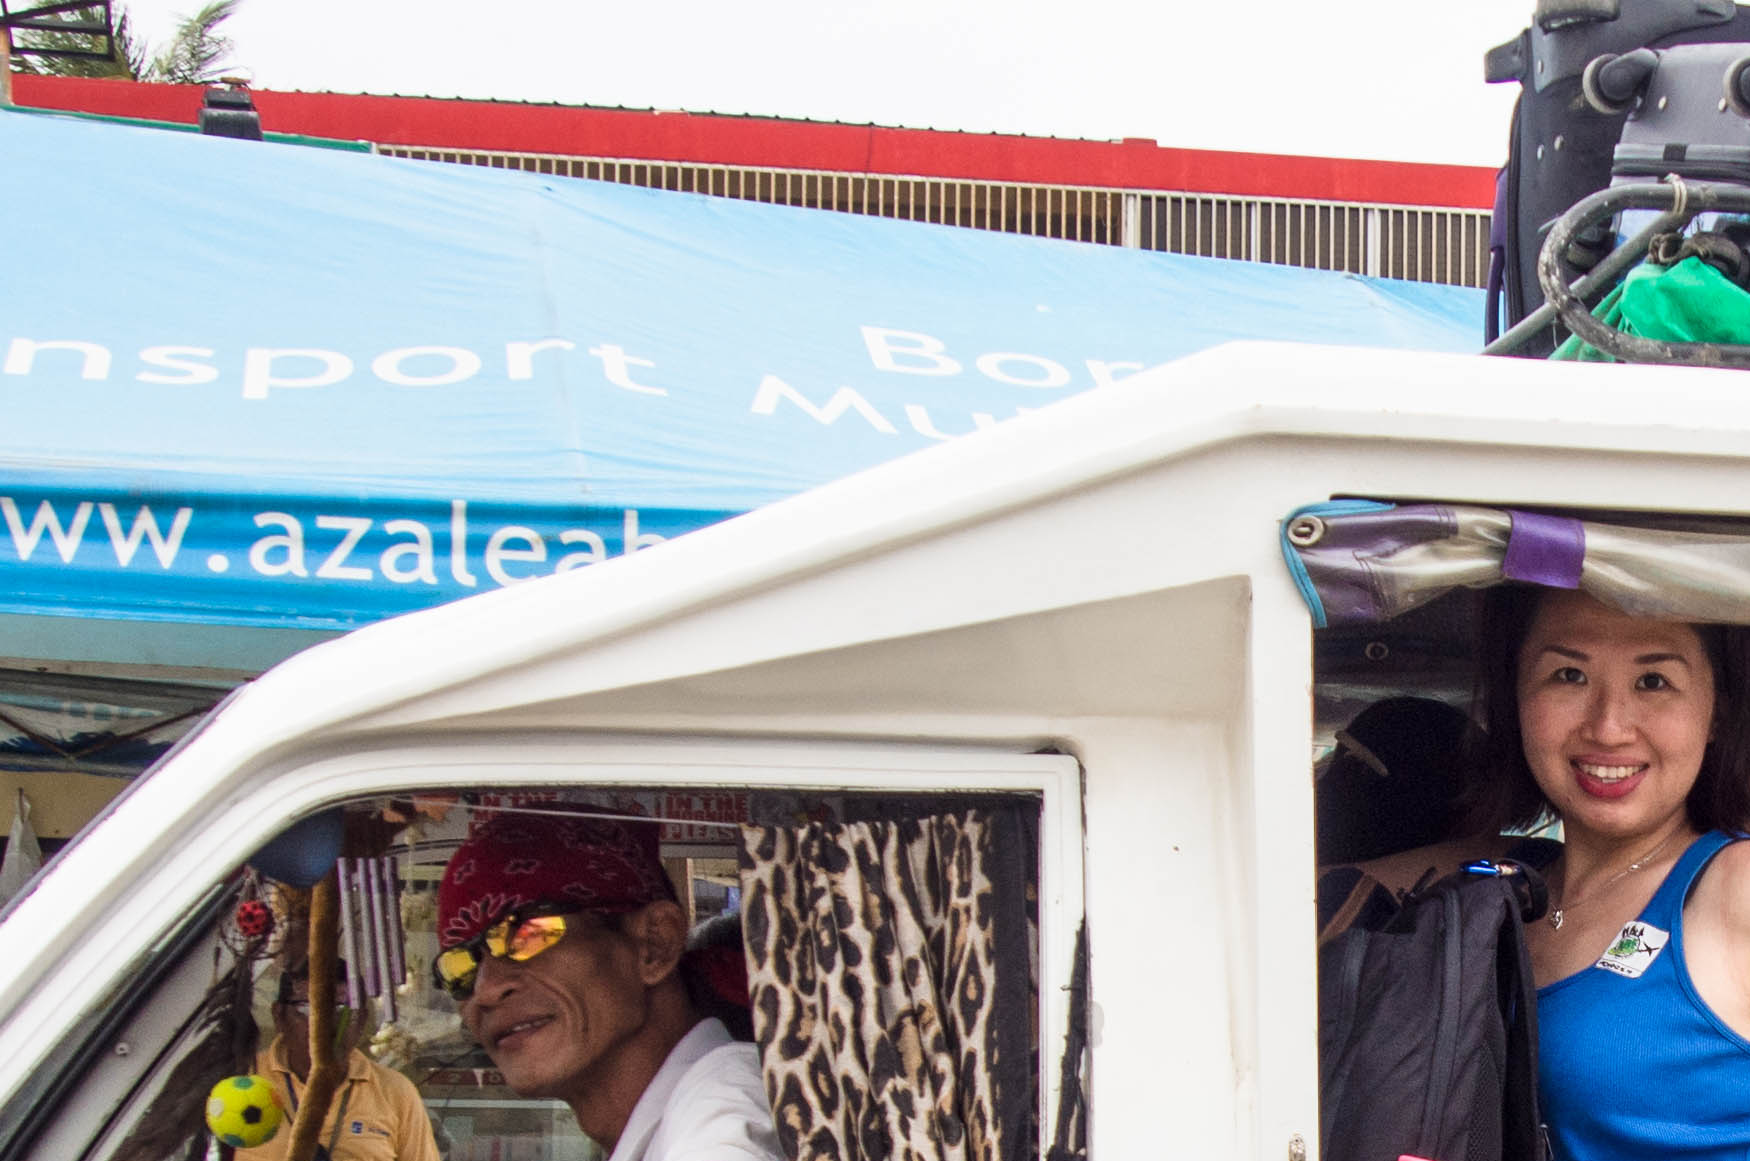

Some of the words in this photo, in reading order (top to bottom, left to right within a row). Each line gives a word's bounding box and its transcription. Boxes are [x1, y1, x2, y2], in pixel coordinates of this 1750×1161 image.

[3, 337, 668, 400] nsport
[751, 374, 1037, 442] Mu
[665, 823, 738, 840] PLEAS
